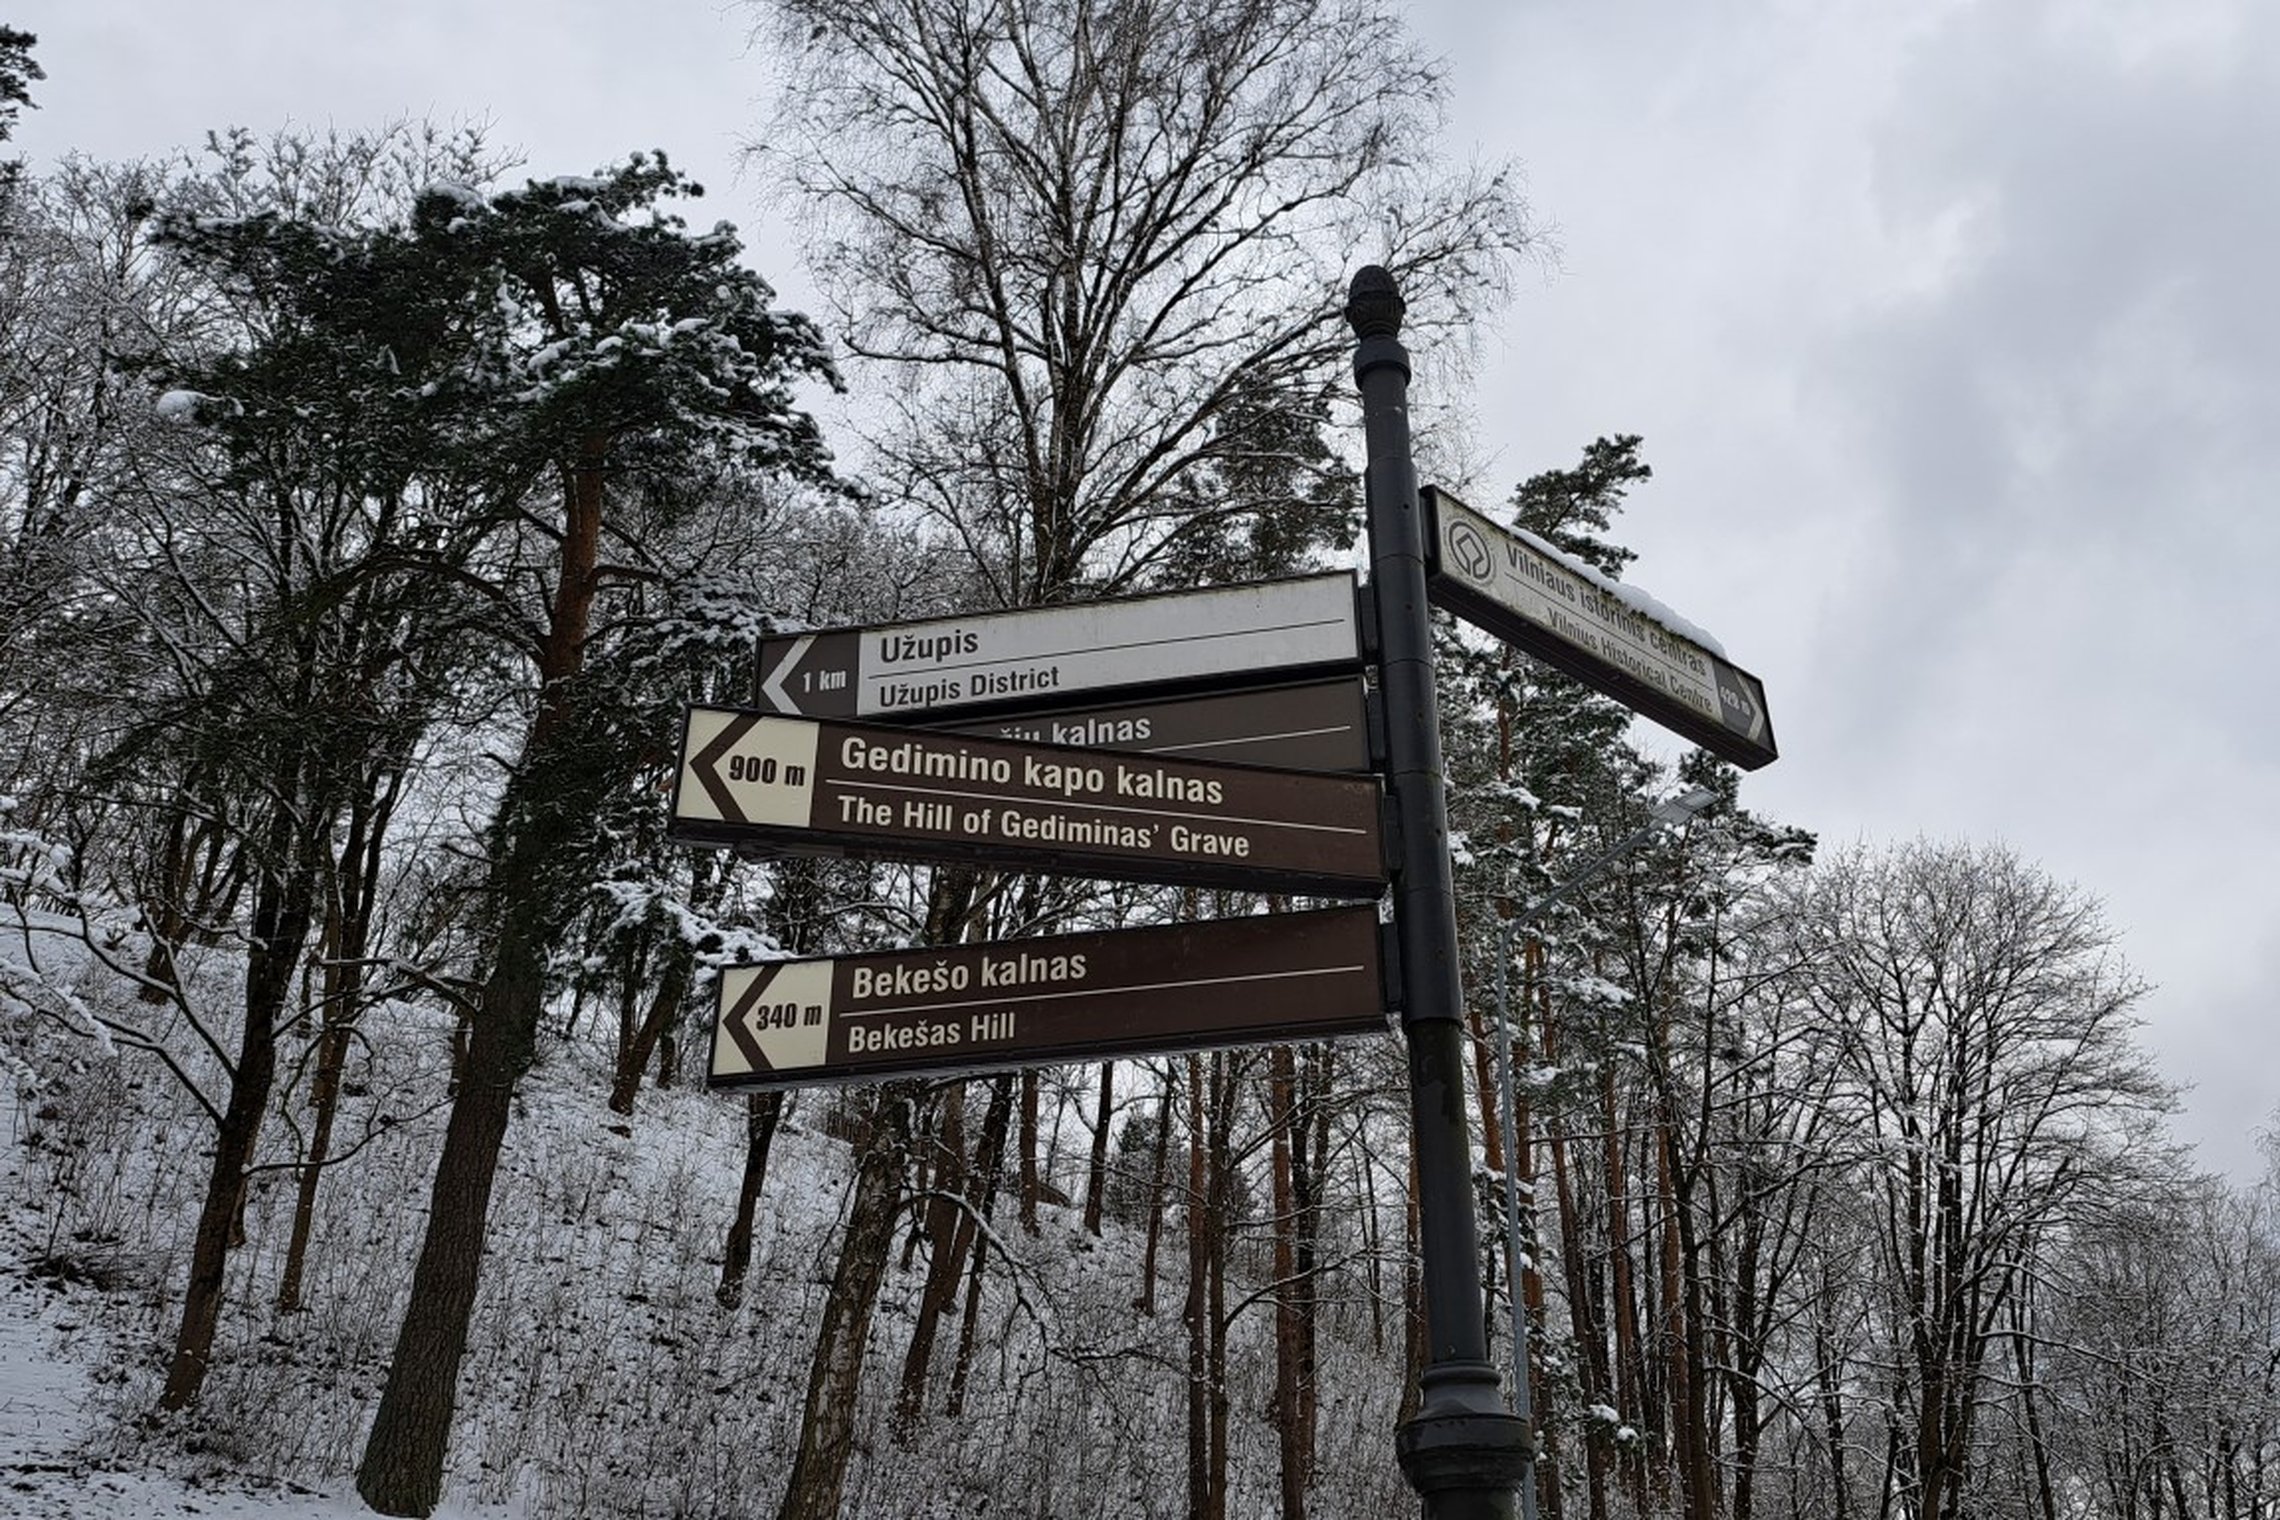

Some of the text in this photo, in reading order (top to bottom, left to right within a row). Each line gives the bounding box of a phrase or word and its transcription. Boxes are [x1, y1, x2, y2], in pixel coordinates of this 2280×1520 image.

[1505, 543, 1707, 677] Vilniaus istorinis centras
[880, 629, 979, 663] Užupis
[1547, 606, 1713, 713] Vilnius Historical Centre
[803, 669, 847, 693] 1 km
[880, 666, 1060, 708] Užupis District
[1052, 718, 1151, 746] kalnas
[729, 755, 805, 786] 900 m
[841, 737, 1223, 804] Gedimino kapo kalnas
[838, 795, 892, 826] The
[903, 801, 953, 831] Hill
[963, 808, 991, 834] of
[1170, 825, 1250, 857] Grave
[852, 953, 1087, 999] Bekešo kalnas
[756, 1003, 823, 1032] 340 m
[848, 1012, 1016, 1053] Bekešas Hill
